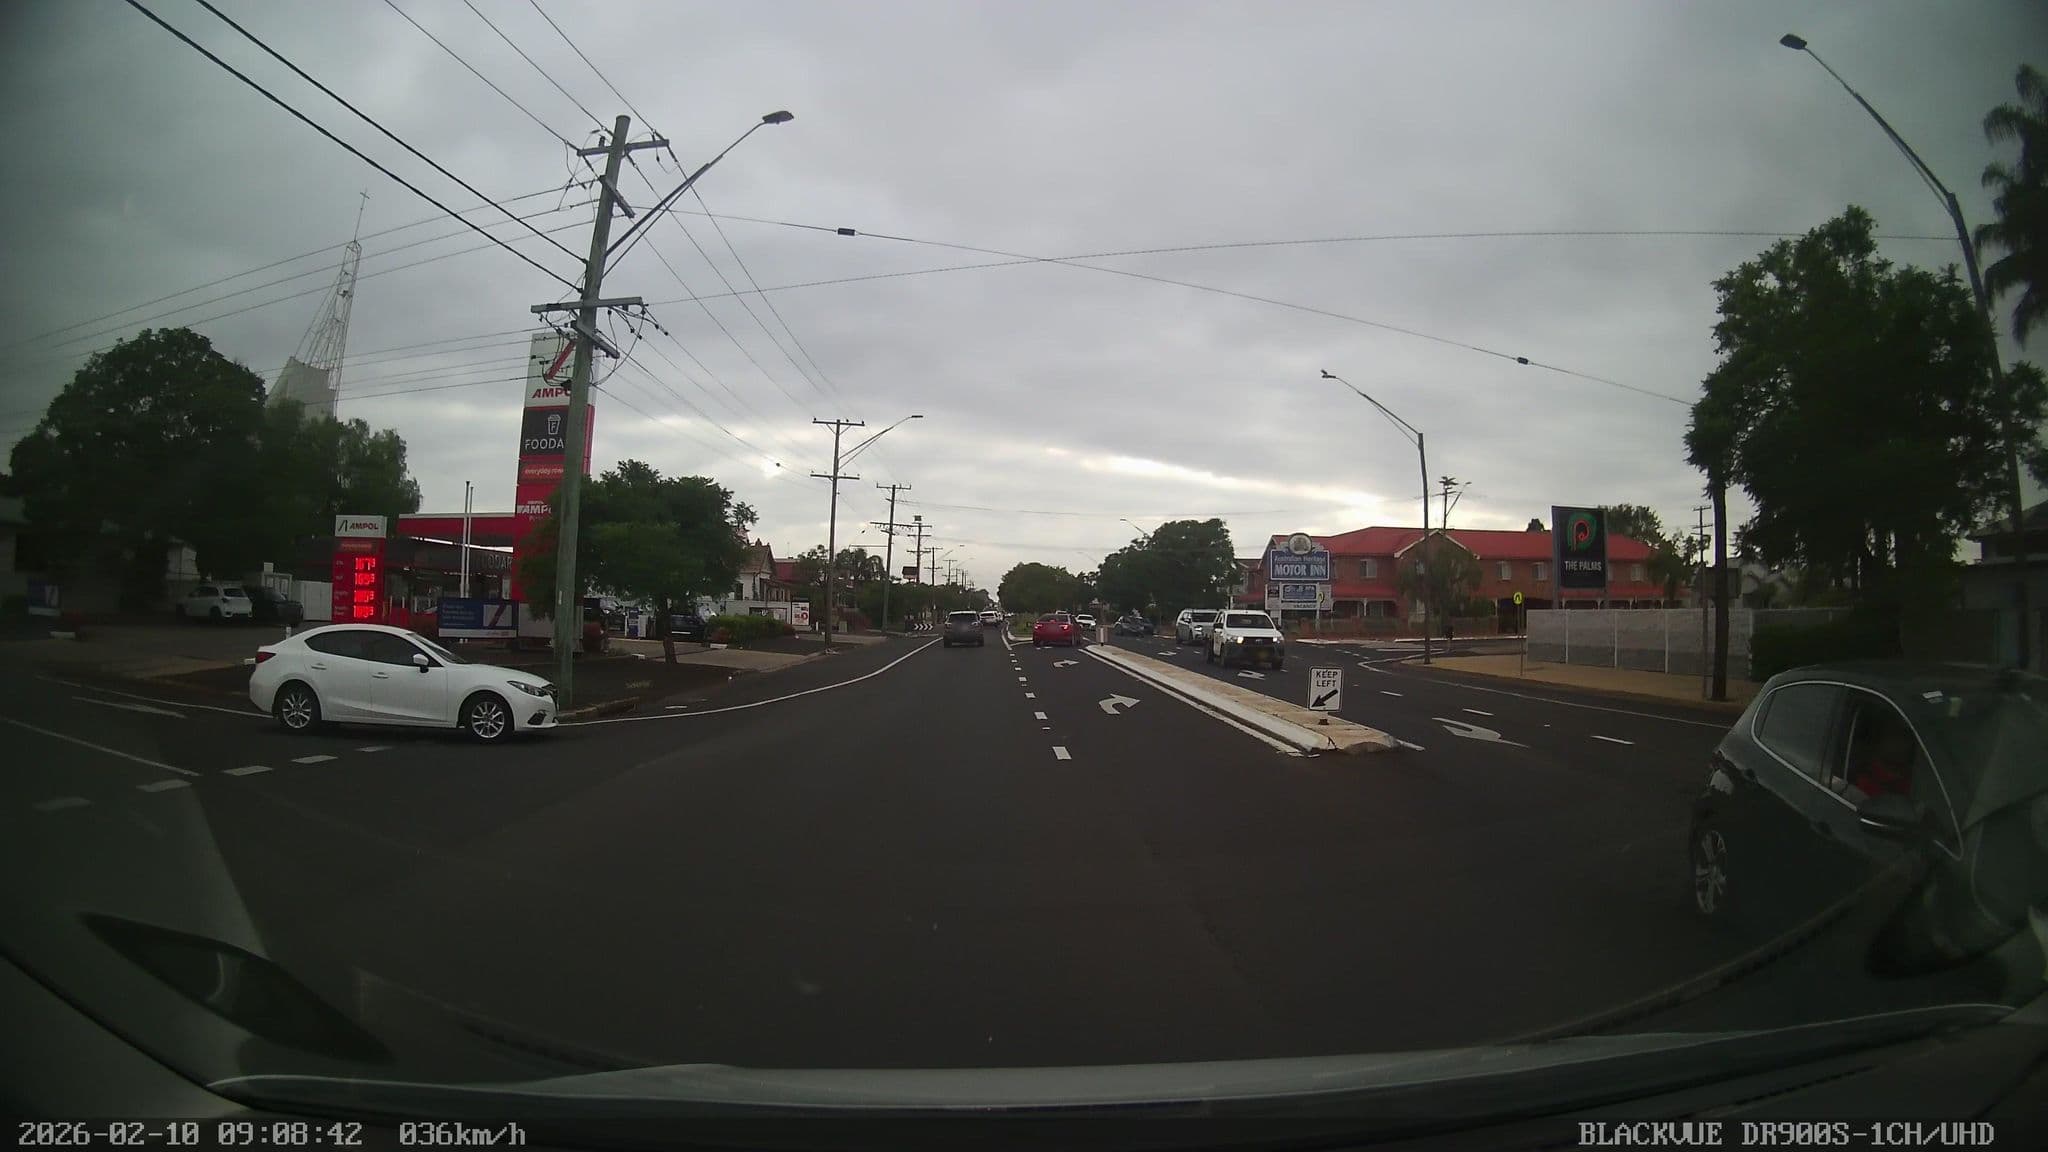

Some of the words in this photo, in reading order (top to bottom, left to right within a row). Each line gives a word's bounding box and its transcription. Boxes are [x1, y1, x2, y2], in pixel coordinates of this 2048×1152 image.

[525, 438, 564, 449] FOODA
[350, 522, 379, 530] AMPOL
[1274, 565, 1307, 576] MOTOR
[1309, 565, 1326, 576] INN
[1565, 561, 1578, 571] THE
[1579, 561, 1601, 571] PALMS
